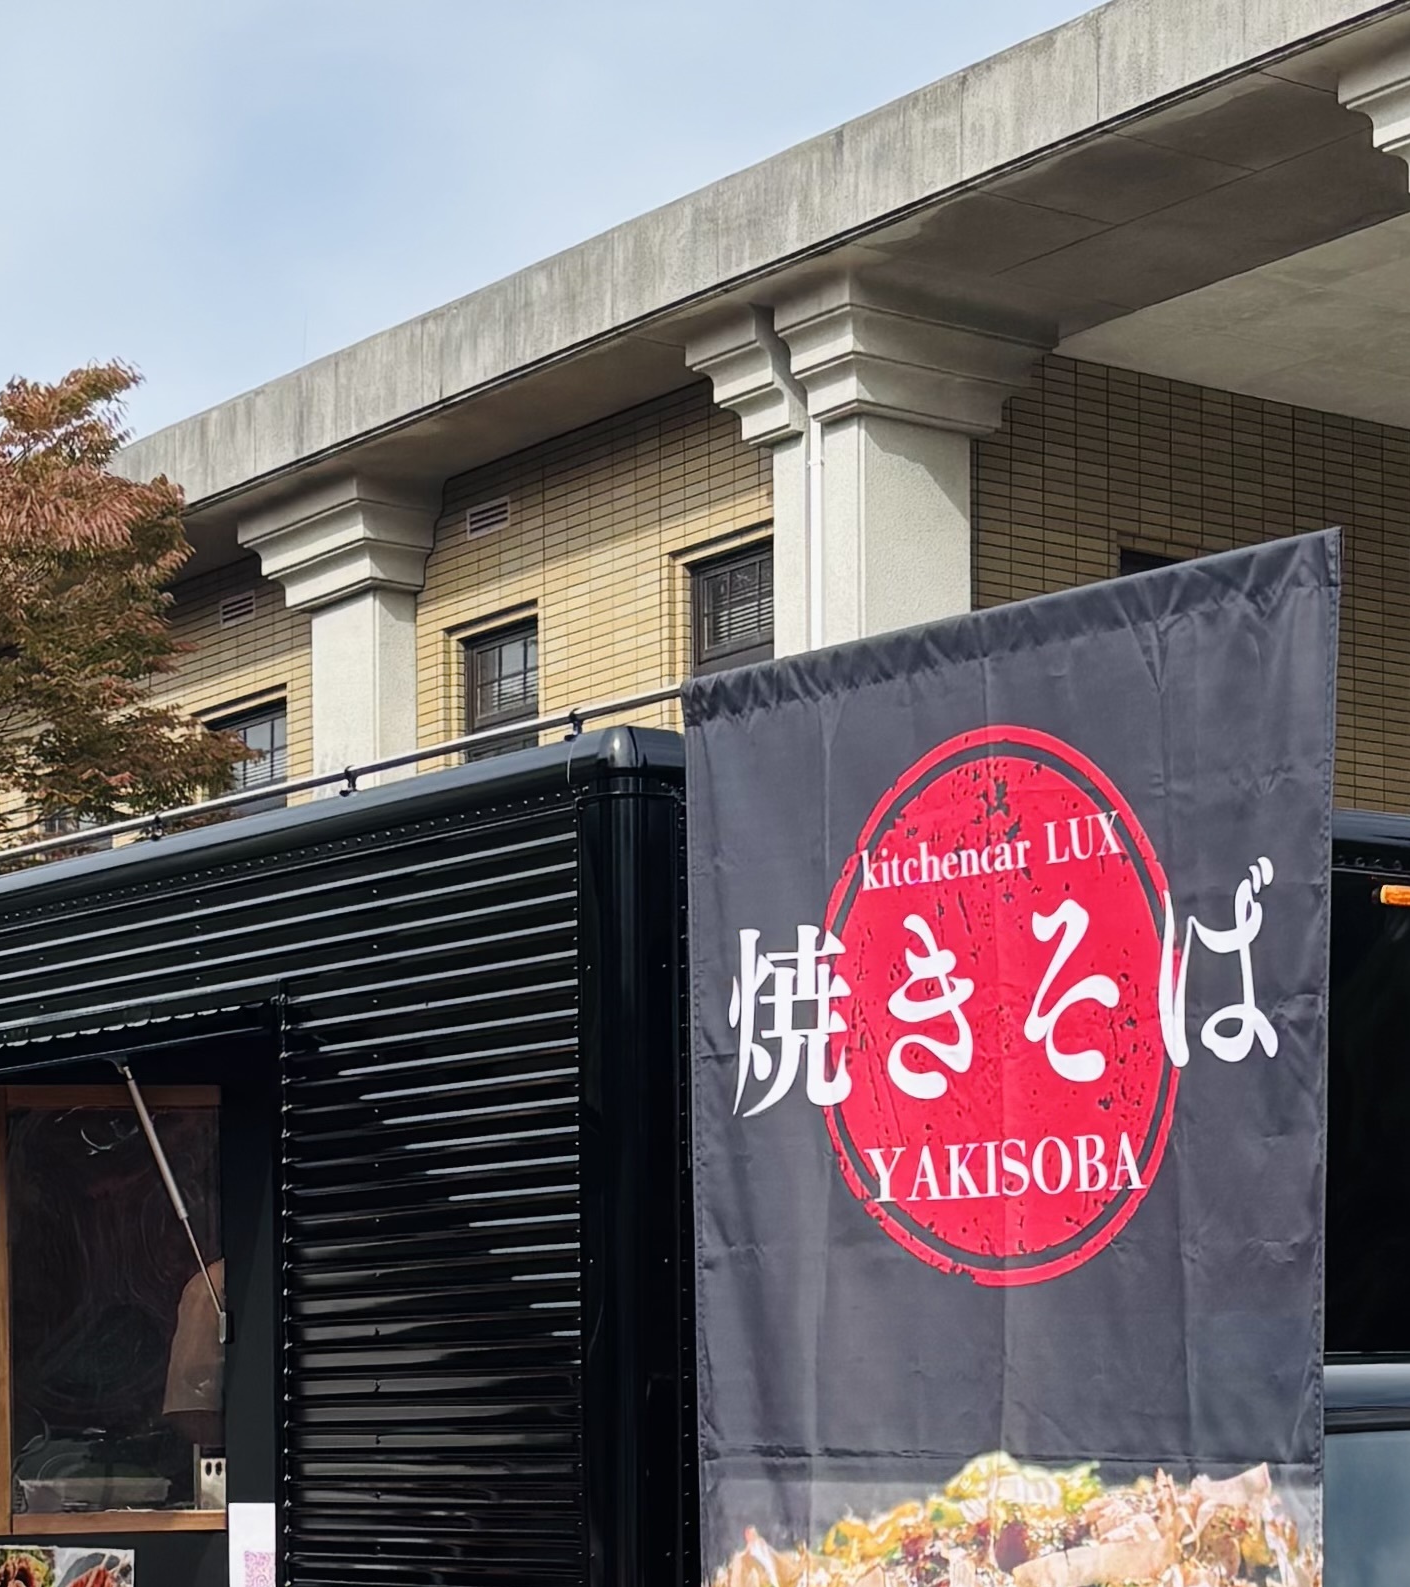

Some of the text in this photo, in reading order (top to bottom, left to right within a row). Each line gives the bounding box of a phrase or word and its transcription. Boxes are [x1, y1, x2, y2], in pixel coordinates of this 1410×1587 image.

[861, 809, 1126, 892] kitchencar LUX
[727, 855, 1279, 1117] 焼きそば
[863, 1131, 1149, 1203] YAKISOBA
